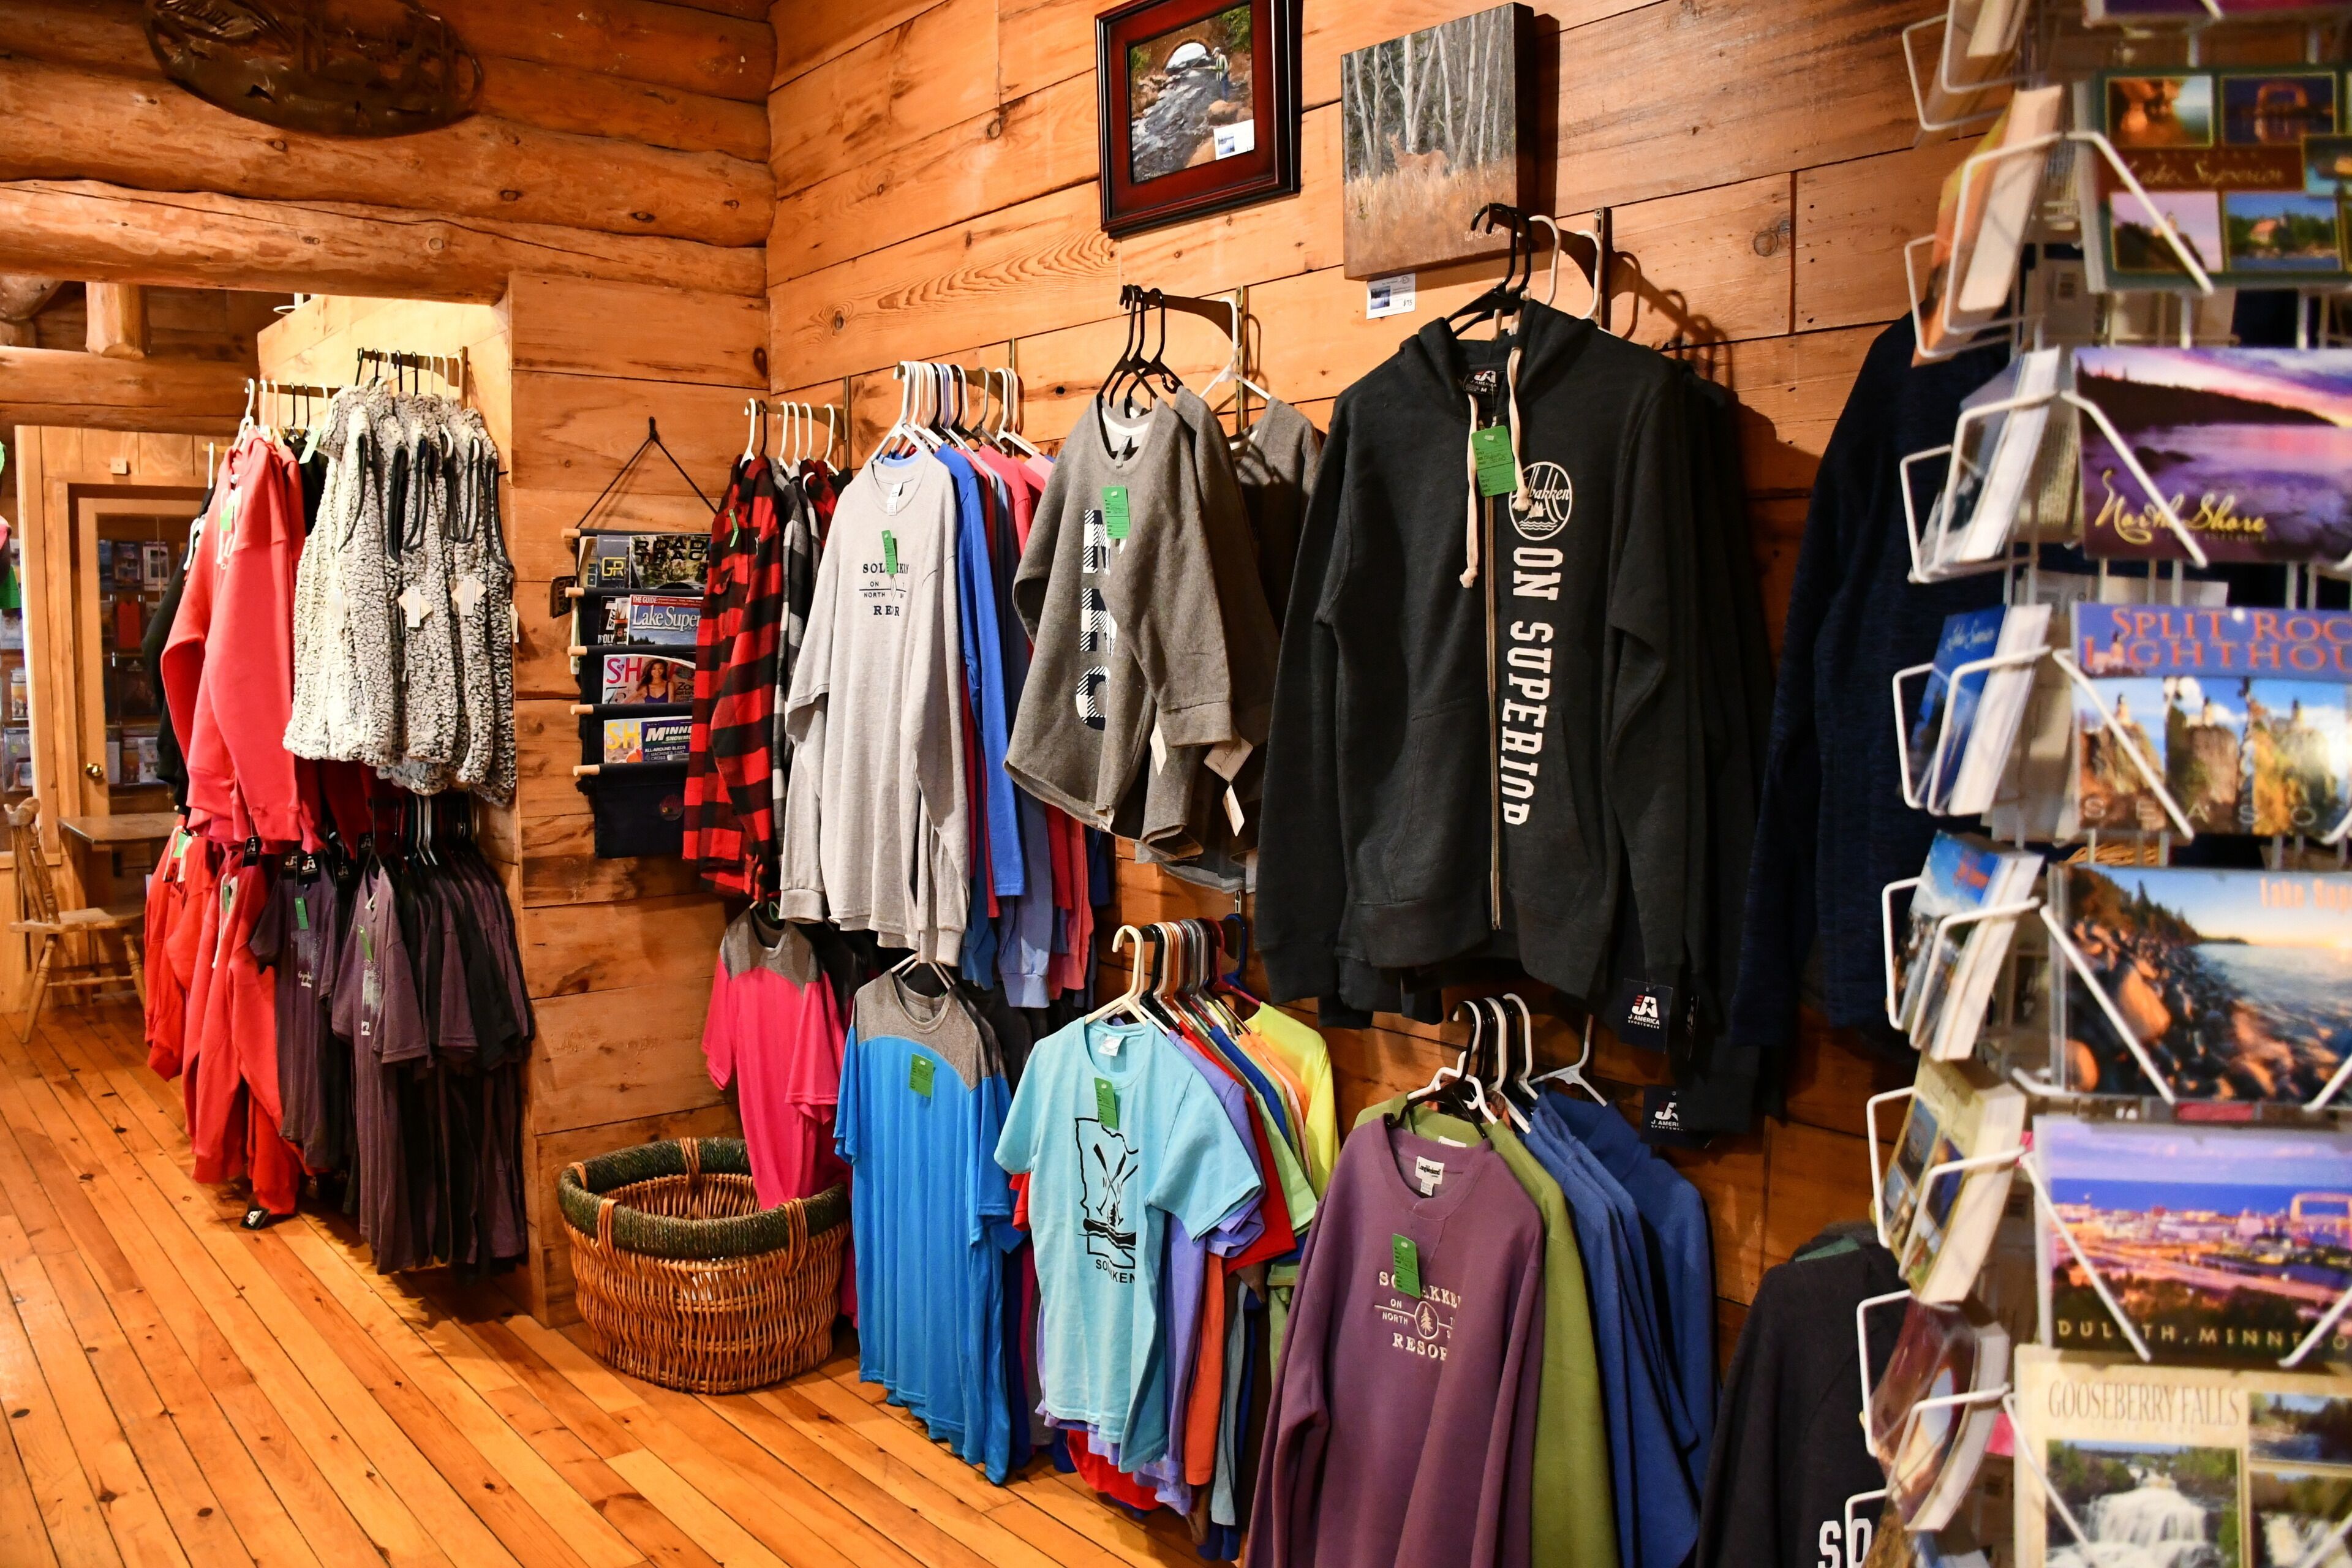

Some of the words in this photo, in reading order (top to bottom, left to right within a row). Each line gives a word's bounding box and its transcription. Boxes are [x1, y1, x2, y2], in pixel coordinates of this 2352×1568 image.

[635, 540, 704, 551] ROAD
[1513, 546, 1564, 601] ON
[632, 605, 664, 626] Lake
[2112, 607, 2231, 641] SPLIT
[1500, 620, 1554, 826] SUPERIOR
[1627, 1019, 1660, 1030] SPORTSWEAR
[1634, 1015, 1660, 1025] AMERICA
[1390, 1298, 1402, 1309] ON
[1382, 1311, 1409, 1325] NORTH
[2057, 1320, 2190, 1344] DULTH,
[2048, 1380, 2177, 1423] GOOSEBERRY
[2180, 1385, 2241, 1427] FALLS
